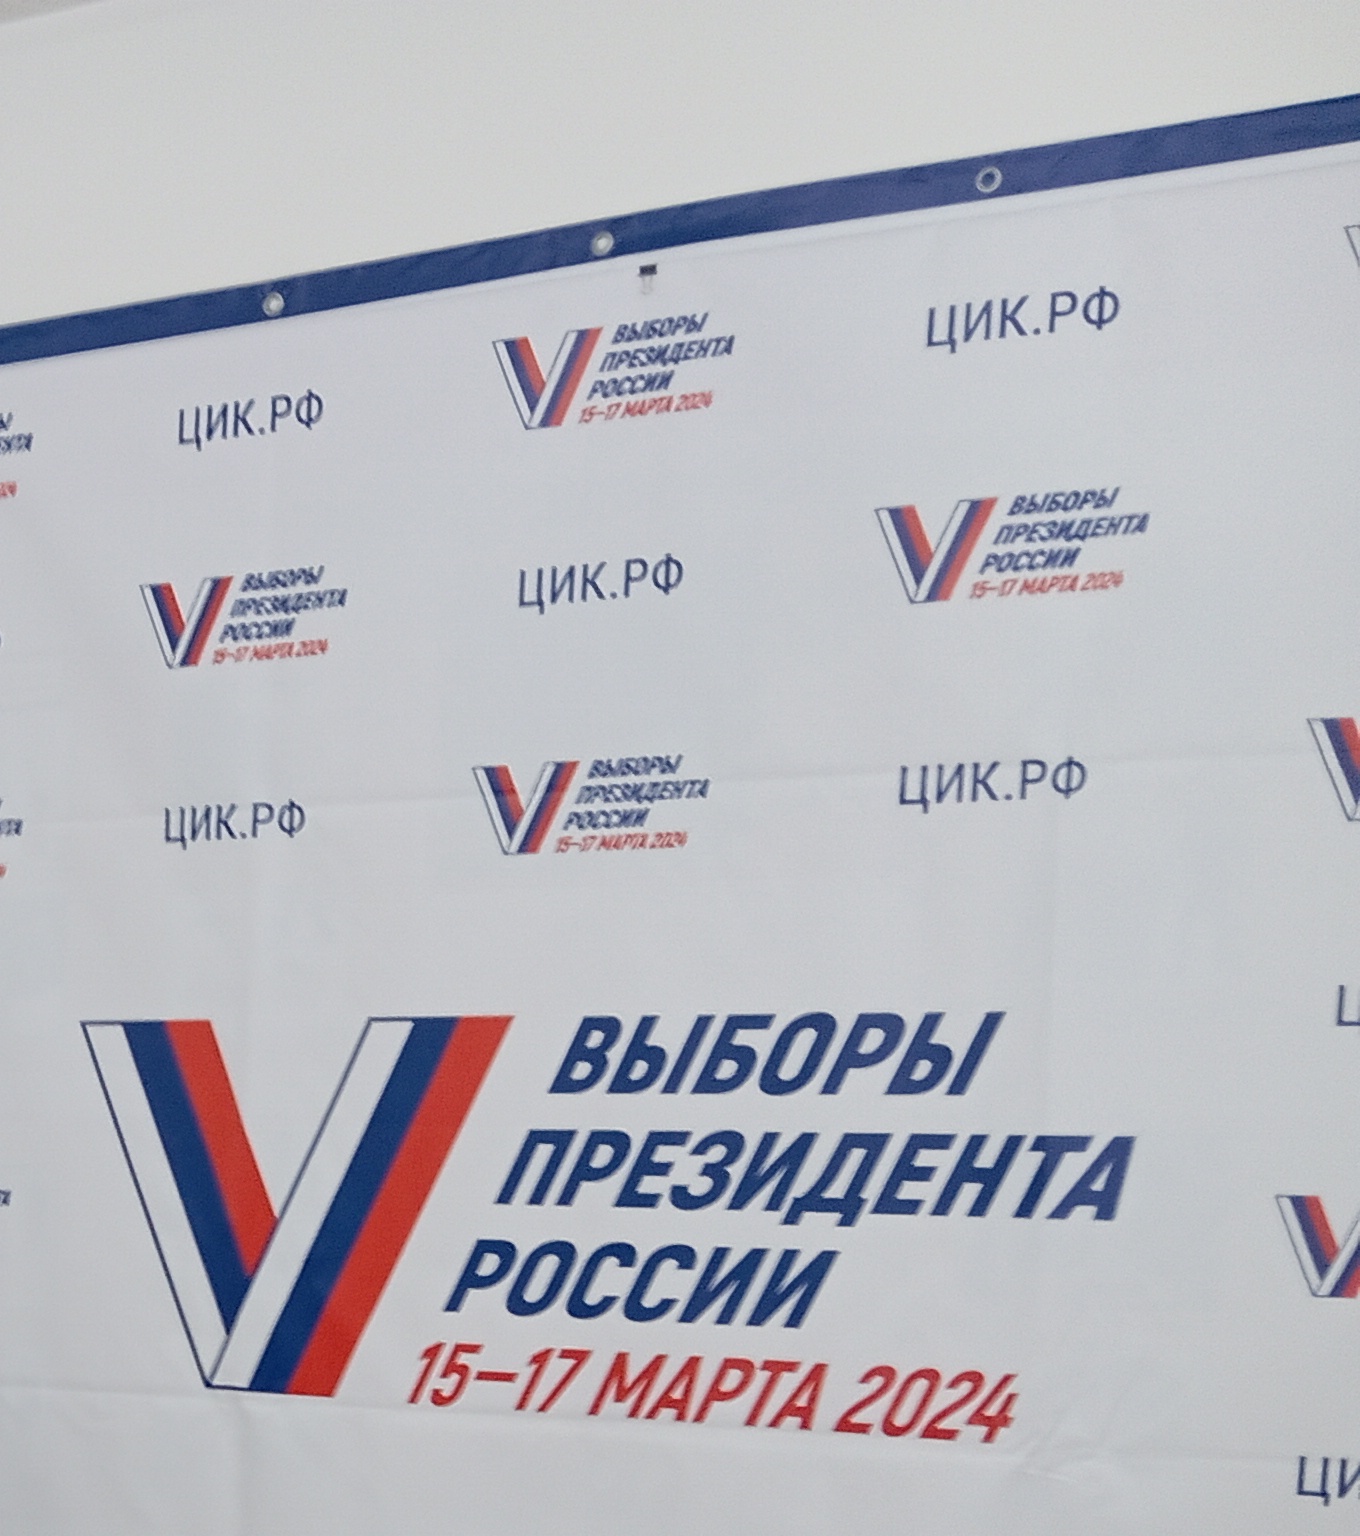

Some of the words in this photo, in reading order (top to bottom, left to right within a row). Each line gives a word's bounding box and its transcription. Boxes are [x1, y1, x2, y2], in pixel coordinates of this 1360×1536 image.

[610, 311, 709, 345] ВЫБОРЫ
[925, 284, 1121, 355] ЦИК.РФ
[597, 335, 735, 373] ПРЕЗИДЕНТА
[585, 369, 676, 401] РОССИИ
[177, 388, 324, 453] ЦИК.РФ
[1006, 486, 1121, 517] ВЫБОРЫ
[992, 512, 1150, 546] ПРЕЗИДЕНТА
[978, 546, 1082, 575] РОССИИ
[239, 565, 325, 593] ВЫБОРЫ
[517, 552, 685, 616] ЦИК.РФ
[229, 587, 347, 618] ПРЕЗИДЕНТА
[219, 617, 297, 643] РОССИИ
[586, 754, 684, 779] ВЫБОРЫ
[574, 778, 709, 805] ПРЕЗИДЕНТА
[897, 755, 1088, 815] ЦИК.РФ
[163, 798, 307, 852] ЦИК.РФ
[562, 807, 651, 831] РОССИИ
[546, 1010, 1008, 1097] ВЫБОРЫ
[493, 1128, 1137, 1228] ПРЕЗИДЕНТА
[442, 1238, 841, 1329] РОССИИ
[586, 1350, 830, 1431] МАРТА
[831, 1364, 1020, 1444] 2024
